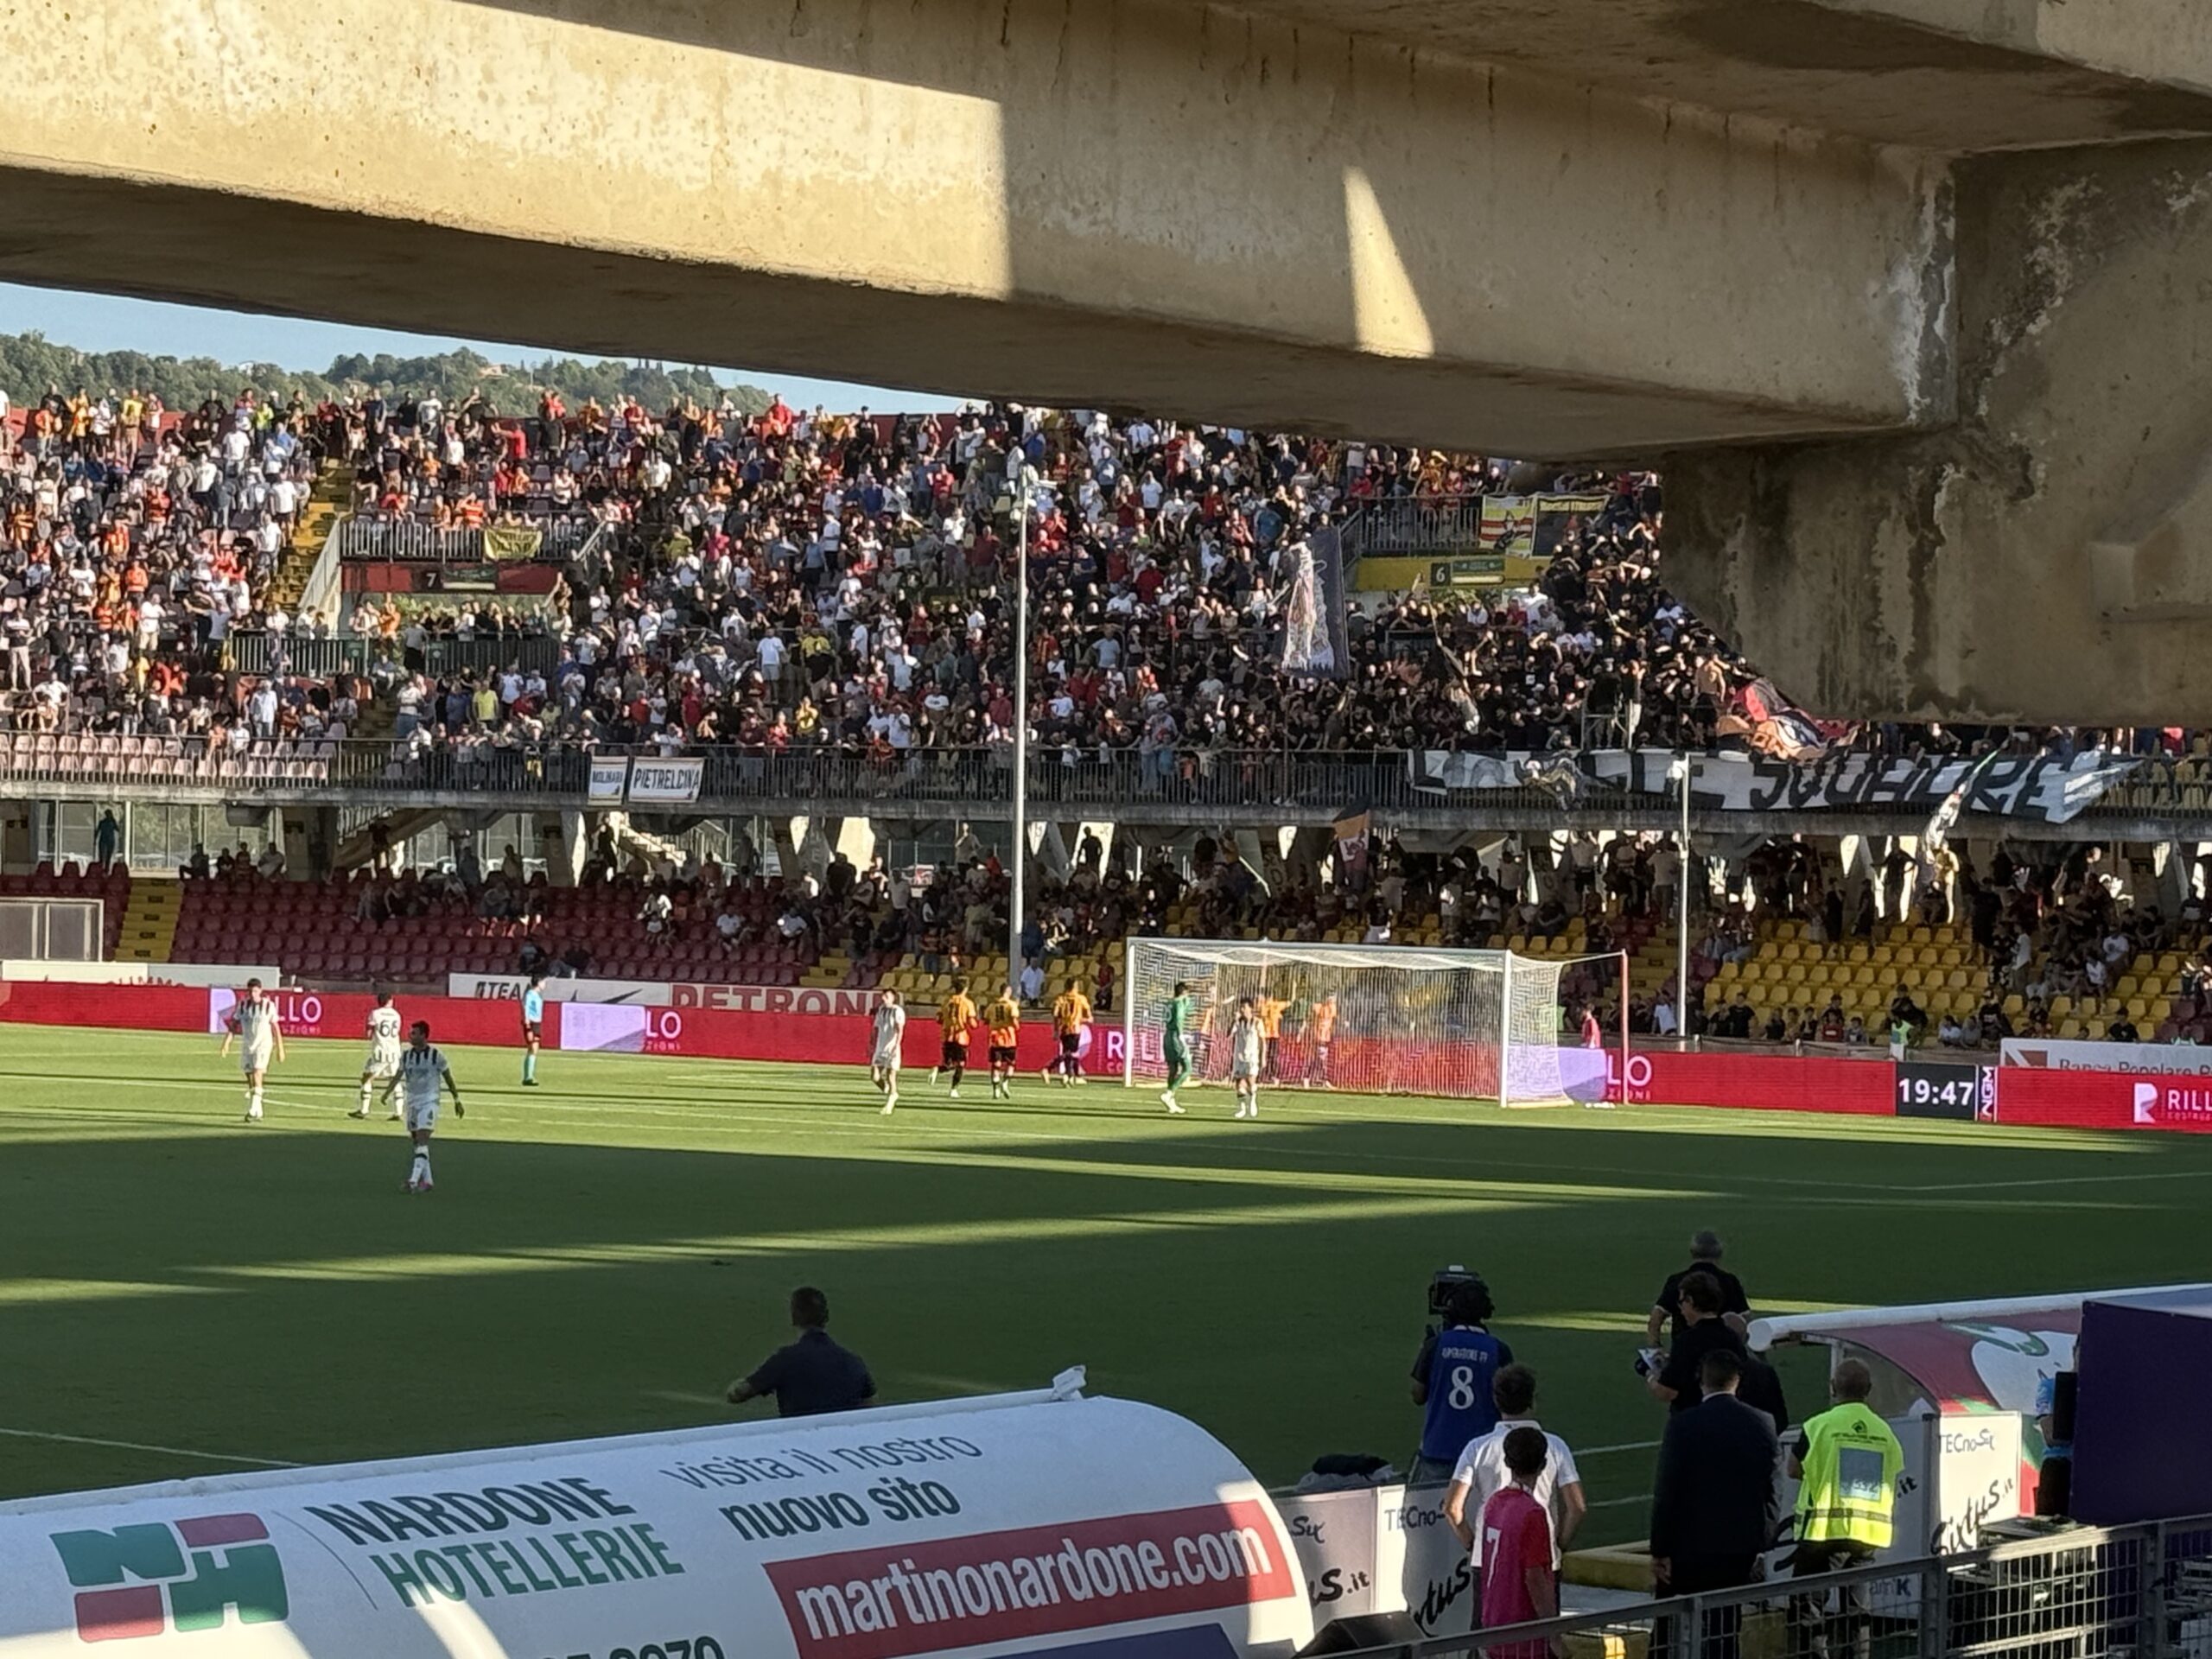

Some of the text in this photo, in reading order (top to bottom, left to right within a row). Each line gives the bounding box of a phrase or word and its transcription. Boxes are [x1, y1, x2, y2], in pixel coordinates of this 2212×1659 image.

[426, 573, 437, 588] 7
[1434, 566, 1446, 582] 6
[632, 768, 701, 790] PIETRELCINA
[1898, 1077, 1974, 1106] 19:47
[1448, 1366, 1475, 1410] 8
[662, 1435, 983, 1489] visita il nostro
[302, 1478, 638, 1546] NARDONE
[718, 1476, 962, 1541] nuovo sito
[368, 1522, 687, 1608] HOTELLERIE
[796, 1524, 1273, 1641] martinonardone.com
[1485, 1526, 1503, 1589] 7
